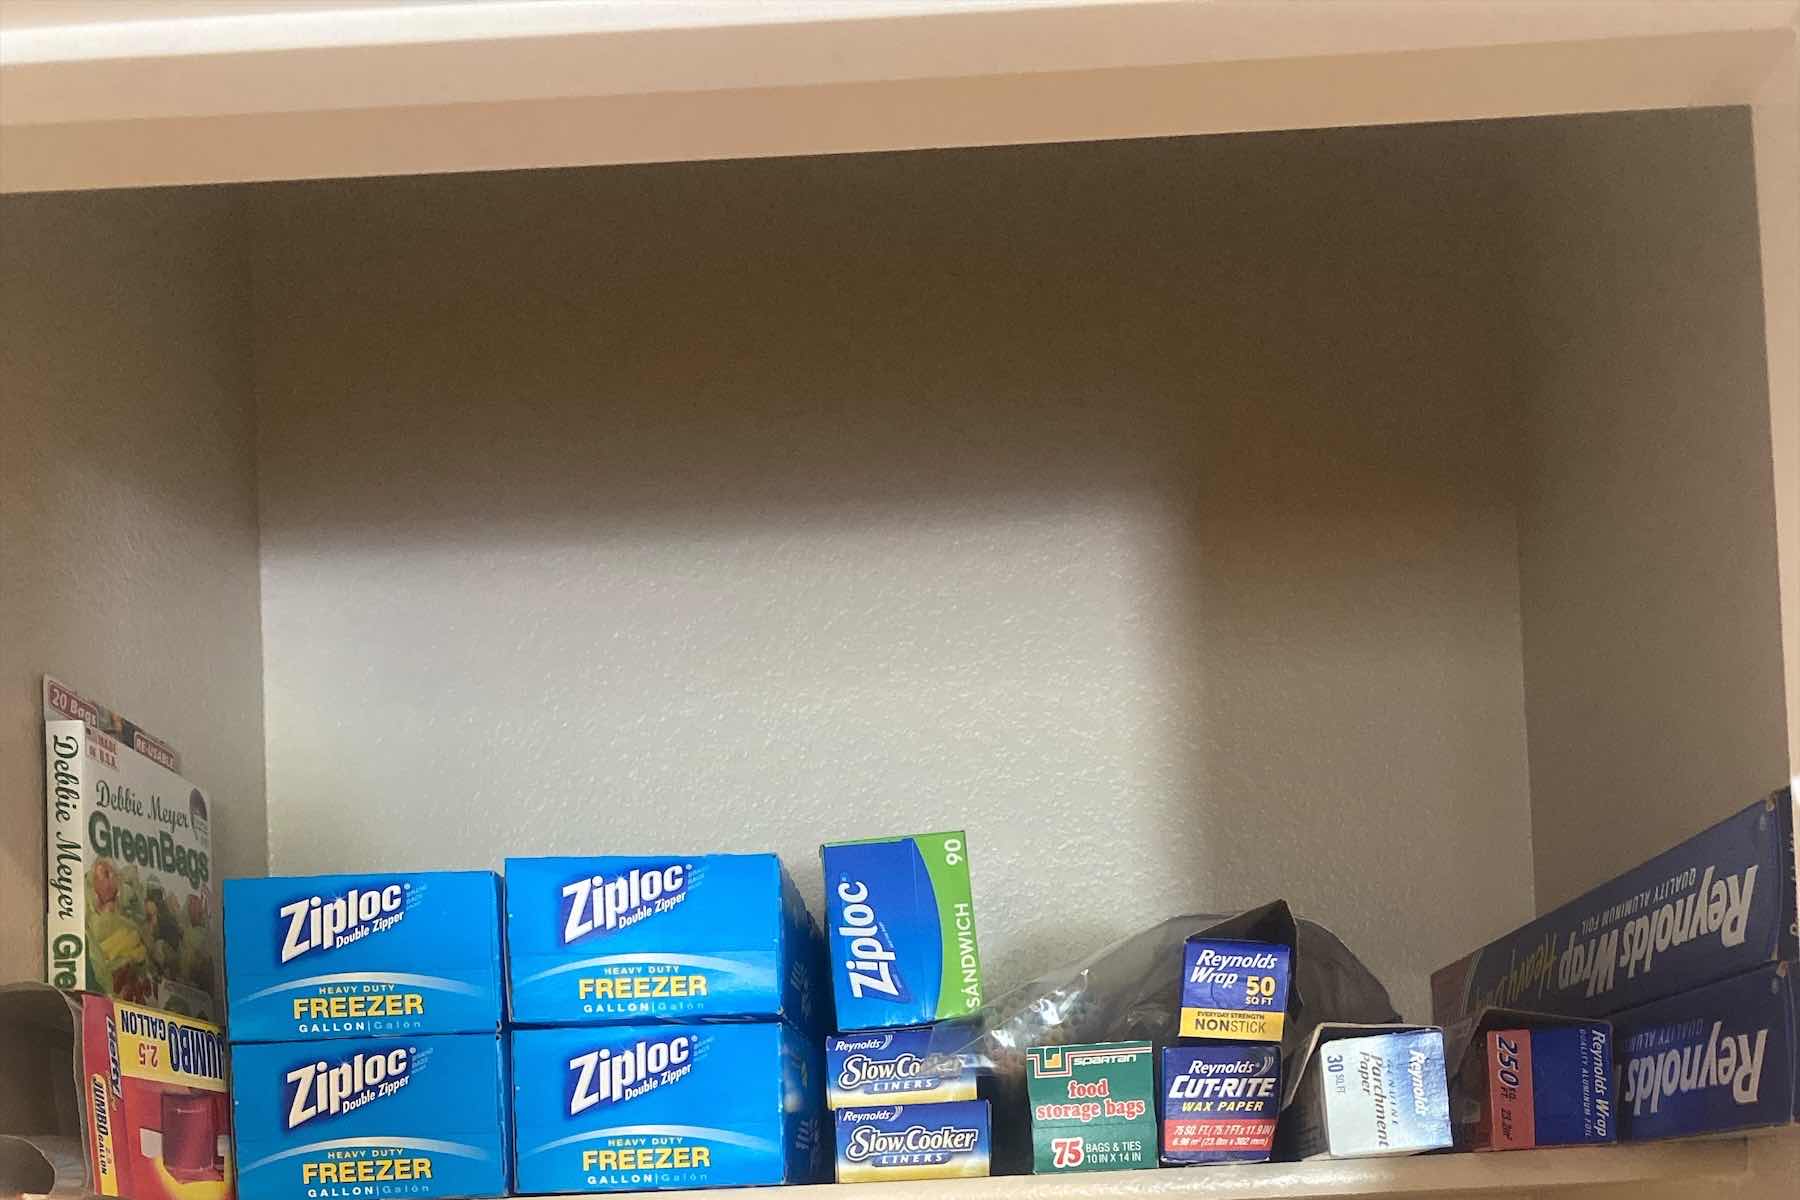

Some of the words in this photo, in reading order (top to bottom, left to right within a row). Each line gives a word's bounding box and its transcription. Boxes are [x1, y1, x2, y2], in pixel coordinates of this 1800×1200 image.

[52, 688, 67, 709] 20
[70, 701, 97, 727] Bags
[53, 735, 80, 823] Debbie
[96, 780, 143, 817] Debbie
[148, 795, 189, 833] Meyer
[88, 811, 208, 888] GreenBags
[945, 838, 962, 866] 90
[56, 831, 83, 921] Meyer
[1652, 867, 1696, 905] QUALITY
[562, 864, 685, 944] Ziploc
[619, 906, 652, 929] Double
[655, 891, 687, 913] Zipper
[1602, 892, 1650, 923] ALUMINUM
[281, 883, 402, 964] Ziploc
[336, 926, 369, 949] Double
[372, 911, 404, 933] Zipper
[1582, 918, 1600, 937] FOIL
[1620, 865, 1758, 979] Reynolds
[838, 880, 899, 999] Ziploc
[604, 967, 643, 976] HEAVY
[648, 965, 680, 974] DUTY
[954, 903, 980, 1010] SANDWICH
[1197, 950, 1277, 970] Reynolds
[1558, 930, 1618, 998] Wrap
[319, 985, 357, 994] HEAVY
[363, 983, 395, 992] DUTY
[578, 975, 708, 1000] FREEZER
[1190, 967, 1238, 988] Wrap
[1246, 976, 1275, 995] 50
[293, 994, 423, 1019] FREEZER
[583, 1003, 649, 1013] GALLON
[1245, 997, 1260, 1005] SQ
[1262, 997, 1273, 1005] FT
[299, 1021, 365, 1033] GALLON
[1195, 1019, 1266, 1033] NONSTICK
[121, 1009, 165, 1041] GALLON
[168, 1021, 224, 1080] JUMBO
[139, 1042, 159, 1068] 2.5
[835, 1039, 882, 1051] Reynolds
[839, 1055, 897, 1088] Slow
[1189, 1060, 1254, 1077] Reynolds
[1327, 1055, 1344, 1073] 30
[1358, 1051, 1372, 1096] Paper
[1497, 1033, 1520, 1088] 250
[1590, 1030, 1606, 1096] Reynolds
[1626, 1020, 1768, 1115] Reynolds
[287, 1047, 407, 1129] Ziploc
[569, 1036, 690, 1115] Ziploc
[624, 1079, 658, 1101] Double
[660, 1063, 692, 1085] Zipper
[872, 1078, 933, 1091] LINERS
[1068, 1079, 1109, 1098] food
[1169, 1076, 1275, 1098] CUT-RITE
[1408, 1050, 1426, 1116] Reynolds
[92, 1077, 109, 1136] JUMBO
[342, 1091, 376, 1114] Double
[378, 1075, 410, 1098] Zipper
[1182, 1102, 1211, 1112] WAX
[1217, 1101, 1264, 1111] PAPER
[1369, 1052, 1390, 1148] Parchment
[844, 1110, 892, 1122] Reynolds
[1036, 1102, 1101, 1122] storage
[1104, 1100, 1145, 1120] bags
[1594, 1100, 1609, 1136] Wrap
[98, 1136, 107, 1176] GALLON
[328, 1150, 366, 1159] HEAVY
[372, 1148, 404, 1157] DUTY
[608, 1138, 647, 1147] HEAVY
[652, 1136, 684, 1145] DUTY
[847, 1129, 904, 1161] Slow
[904, 1129, 977, 1152] Cooker
[1052, 1137, 1084, 1168] 75
[1086, 1143, 1110, 1153] BAGS
[1113, 1142, 1120, 1152] &
[1123, 1141, 1141, 1151] TIES
[303, 1158, 432, 1184] FREEZER
[583, 1147, 711, 1171] FREEZER
[881, 1152, 943, 1164] LINERS
[1087, 1154, 1097, 1163] 10
[1099, 1154, 1108, 1163] IN
[1120, 1152, 1132, 1162] 14
[1133, 1152, 1141, 1161] IN
[308, 1186, 374, 1198] GALLON
[587, 1173, 653, 1185] GALLON
